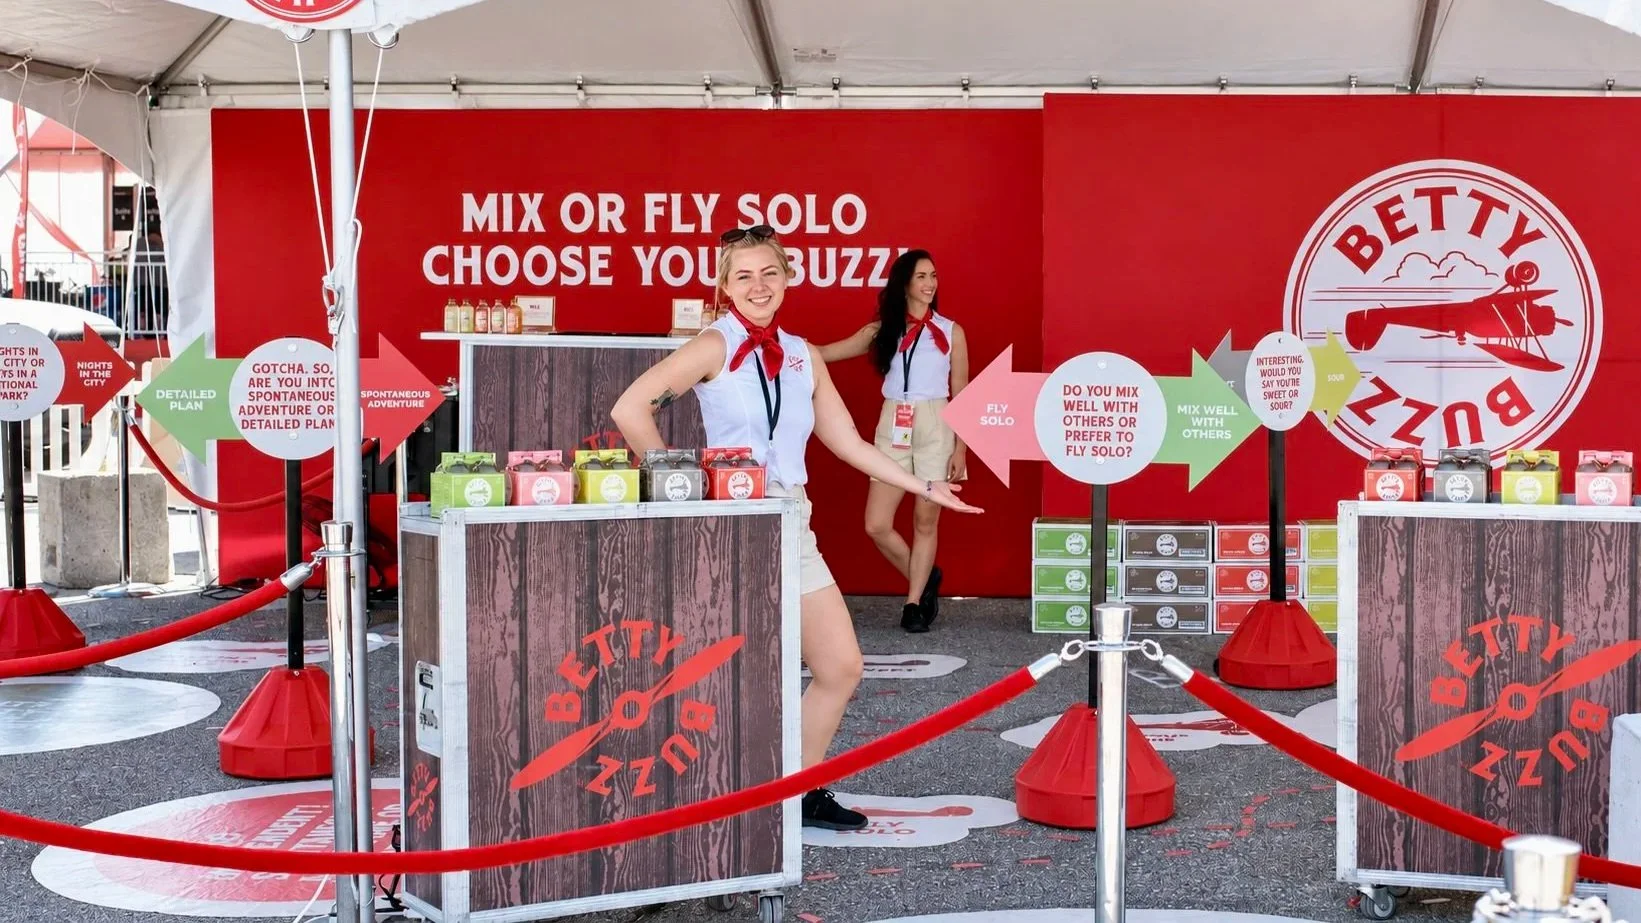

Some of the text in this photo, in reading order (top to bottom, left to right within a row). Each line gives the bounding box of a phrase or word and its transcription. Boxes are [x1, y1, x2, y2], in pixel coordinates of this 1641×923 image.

[461, 192, 867, 235] MIX OR FLY SOLO
[1333, 186, 1548, 274] BETTY
[422, 245, 909, 288] CHOOSE YOU BUZZ
[28, 347, 39, 356] IN
[3, 358, 45, 367] CITY OR
[77, 361, 113, 369] NIGHTS
[17, 369, 27, 378] IN
[31, 369, 37, 378] A
[79, 370, 111, 378] IN THE
[252, 363, 334, 375] GOTCHA. SO,
[1260, 366, 1302, 378] WOULD YOU
[248, 377, 271, 388] ARE
[277, 377, 302, 388] YOU
[1262, 379, 1275, 389] SAY
[156, 389, 216, 400] DETAILED
[360, 390, 431, 399] SPONTANEOUS
[1063, 385, 1139, 397] DO YOU MIX
[1263, 389, 1299, 400] SWEET OR
[169, 401, 203, 411] PLAN
[367, 400, 425, 408] ADVENTURE
[987, 403, 1008, 414] FLY
[1063, 400, 1138, 413] WELL WITH
[1270, 401, 1293, 411] SOUR?
[238, 405, 335, 415] ADVENTURE OR
[1177, 404, 1238, 416] MIX WELL
[1345, 376, 1535, 448] BUZZ
[241, 419, 300, 430] DETAILED
[980, 416, 1015, 426] SOLO
[1063, 415, 1137, 428] OTHERS OR
[1191, 417, 1224, 428] WITH
[1065, 431, 1134, 442] PREFER TO
[1182, 429, 1232, 440] OTHERS
[1066, 445, 1132, 457] FLY SOLO?
[1430, 614, 1577, 708] BETTY
[545, 620, 686, 722] BETTY
[585, 699, 717, 798] BUZZ
[1468, 699, 1610, 788] BUZZ
